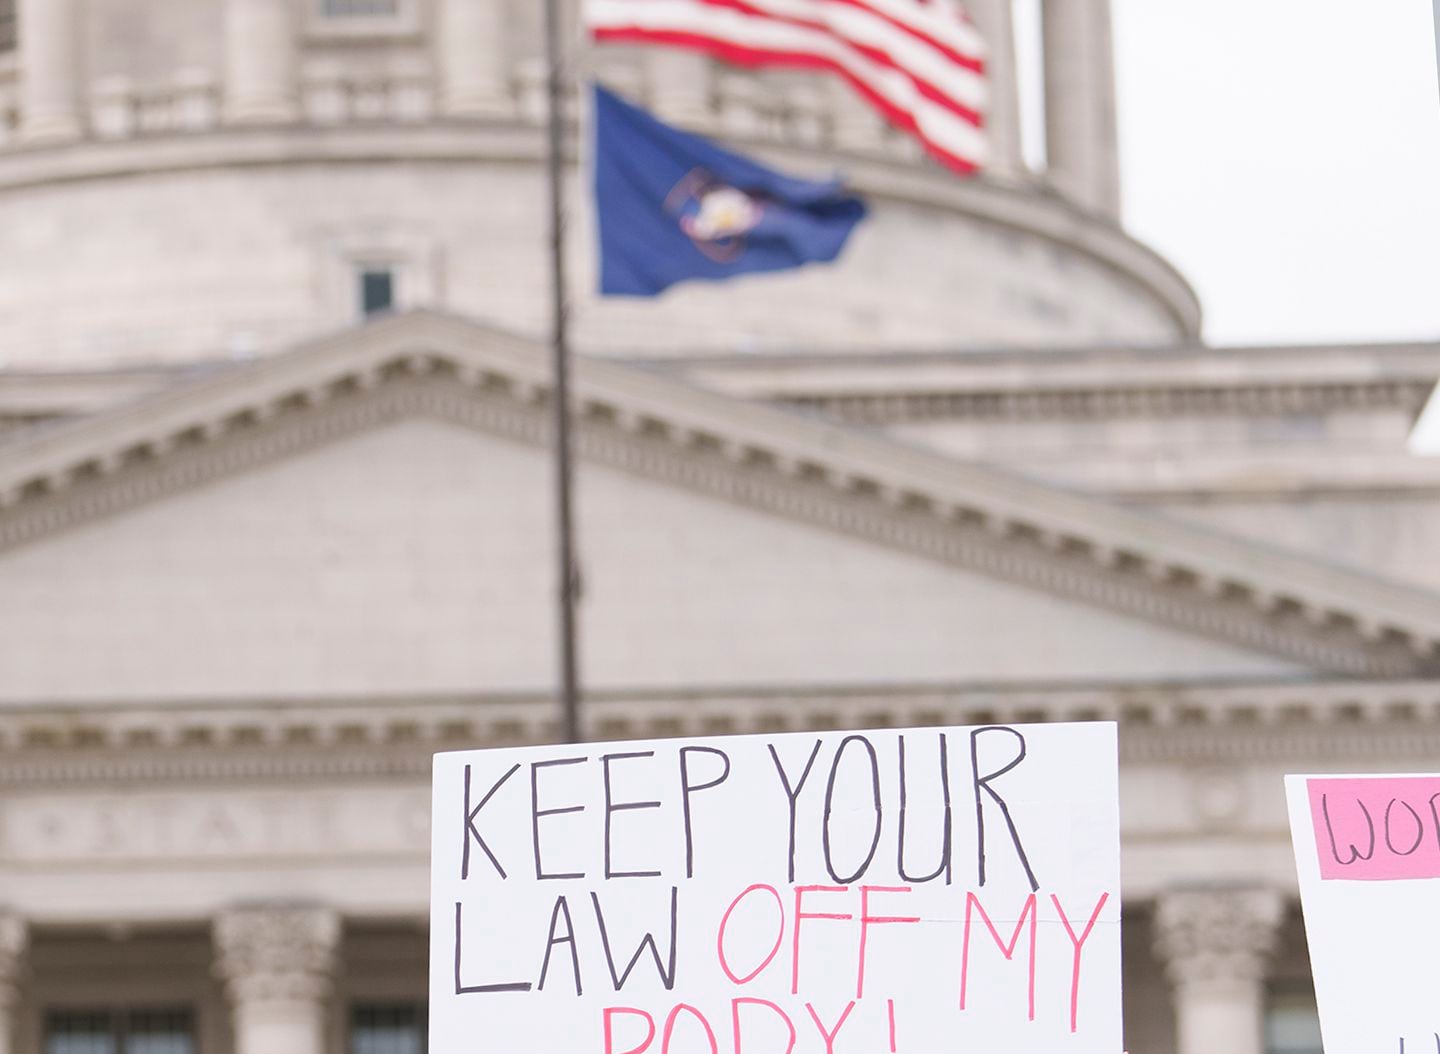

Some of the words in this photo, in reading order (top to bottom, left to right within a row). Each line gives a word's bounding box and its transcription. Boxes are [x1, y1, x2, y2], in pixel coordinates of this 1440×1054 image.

[461, 745, 730, 880] KEEP
[768, 726, 1039, 891] YOUR
[455, 886, 677, 996] LAW
[717, 884, 921, 998] OFF
[959, 891, 1109, 1032] MY
